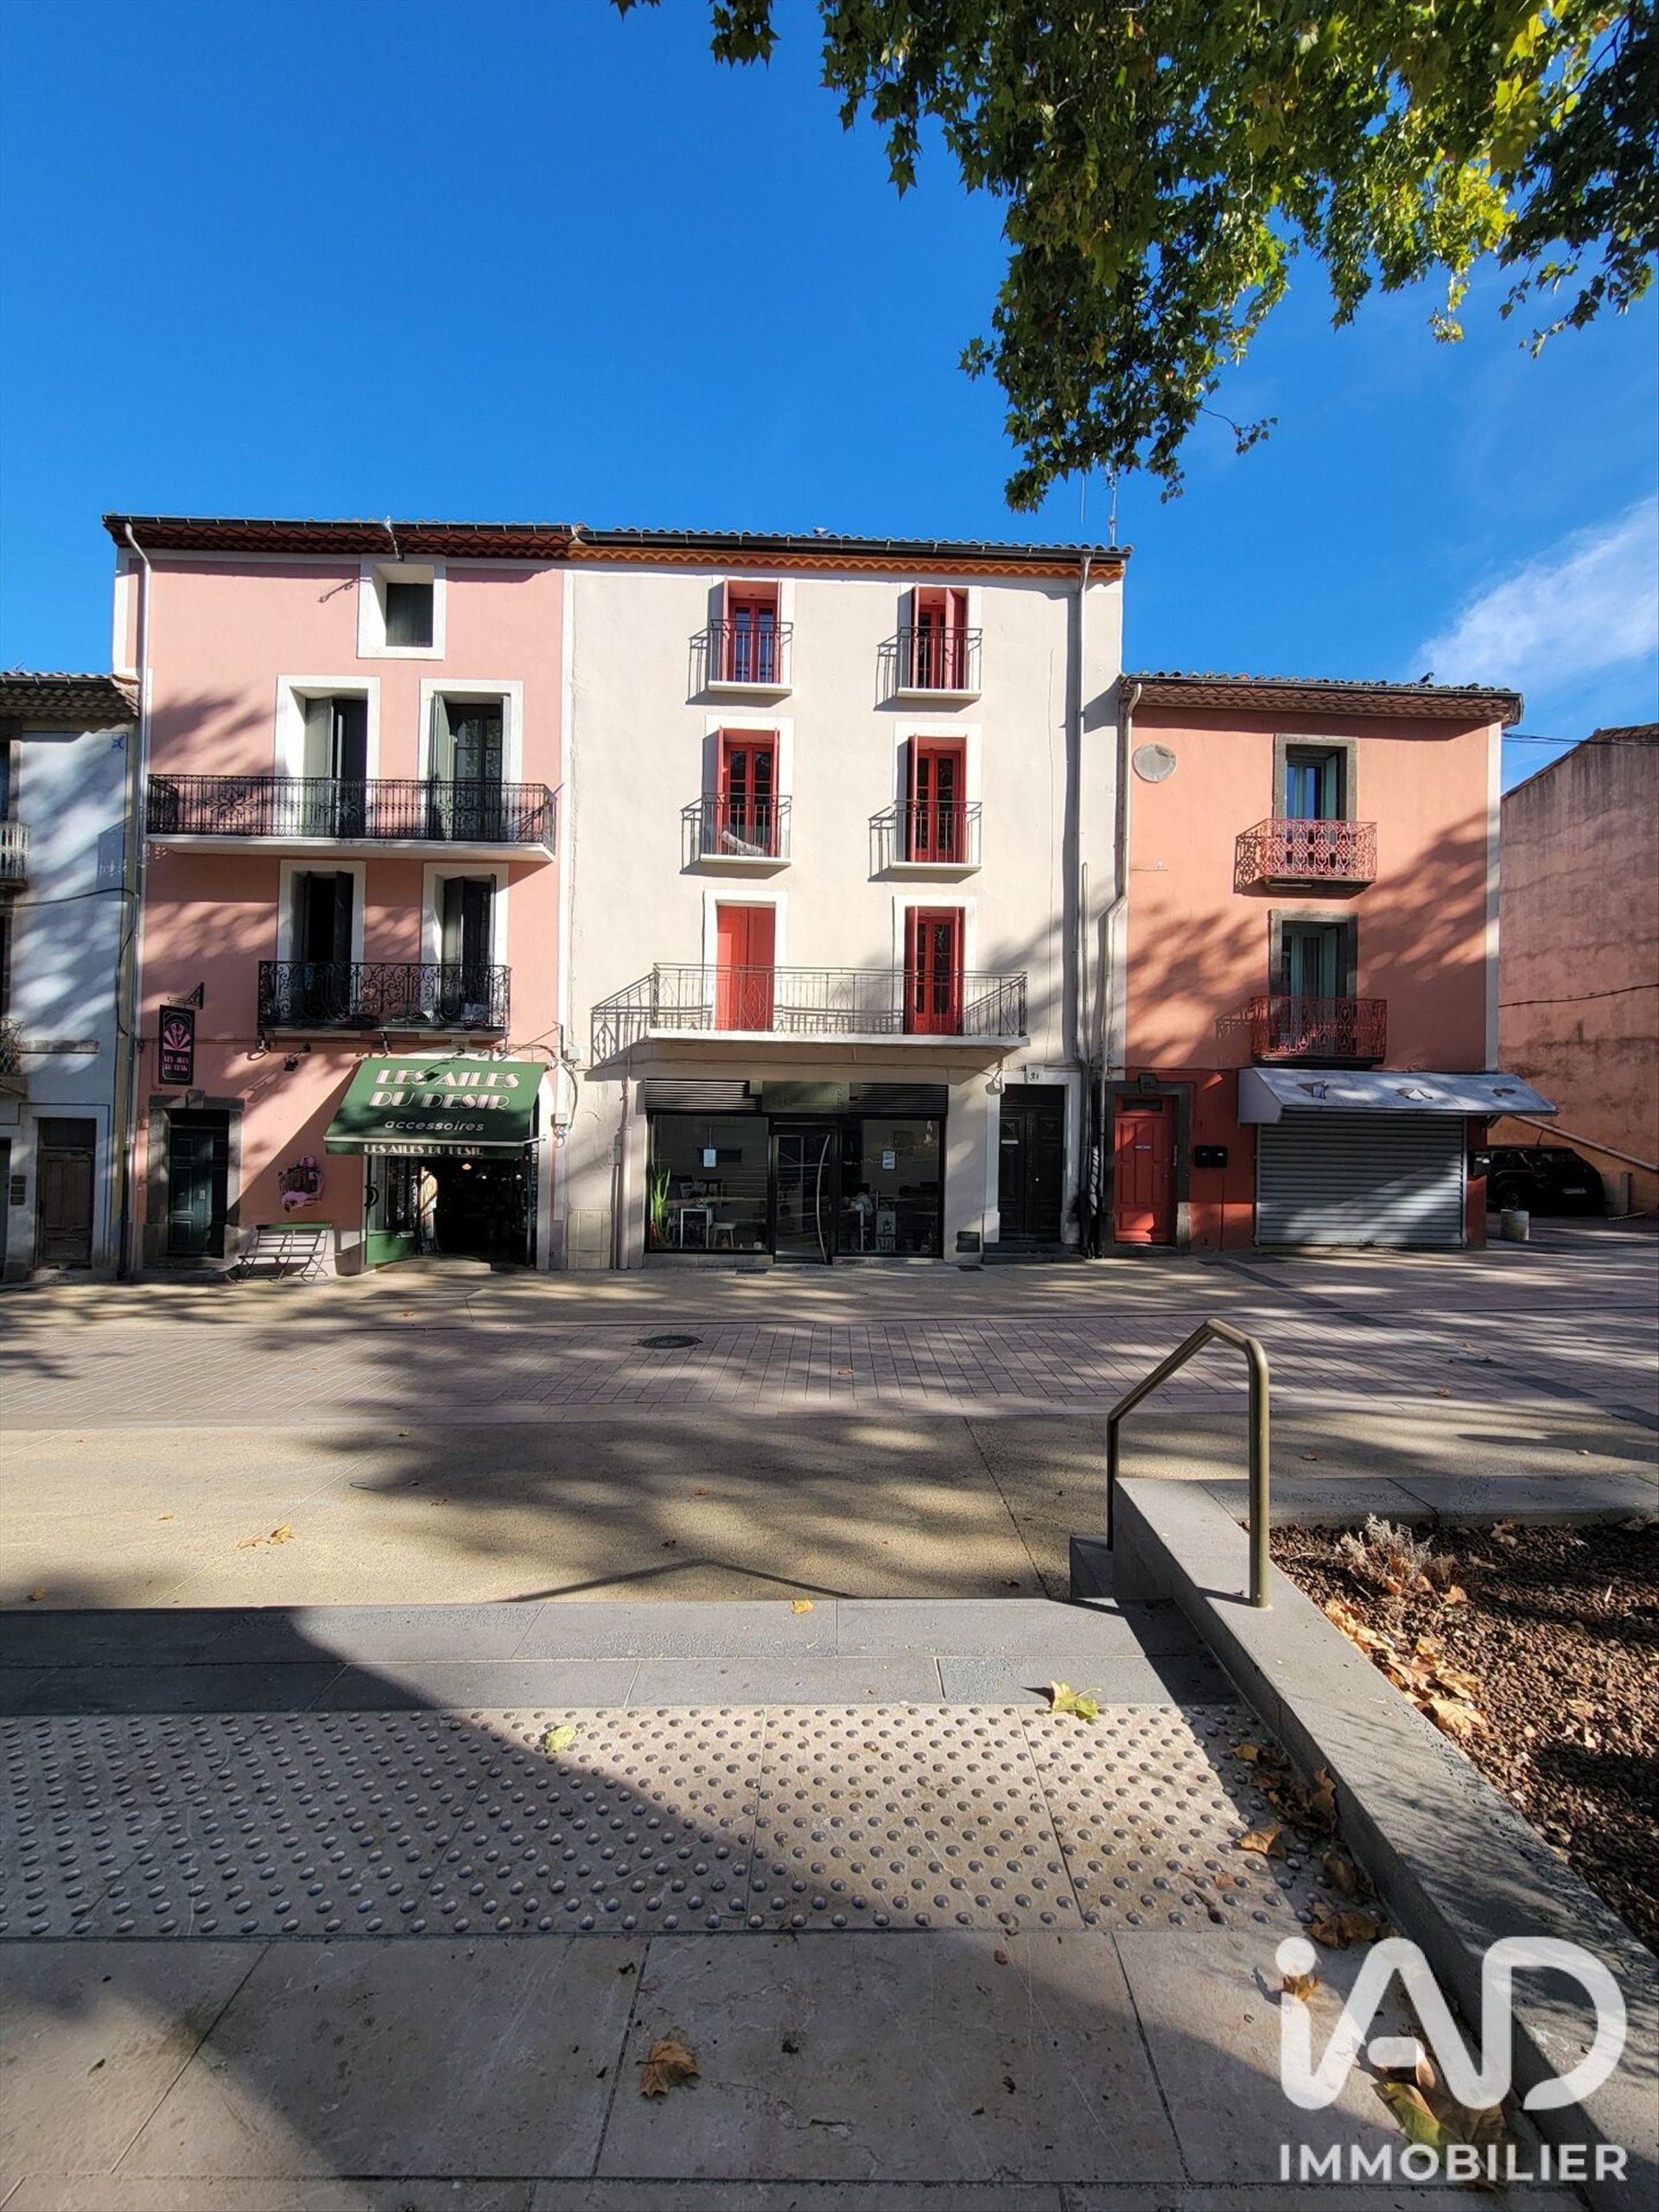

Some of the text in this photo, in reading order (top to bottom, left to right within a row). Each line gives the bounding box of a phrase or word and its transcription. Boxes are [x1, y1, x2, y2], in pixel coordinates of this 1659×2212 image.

[375, 1069, 520, 1088] LES AILES
[369, 1091, 510, 1110] DU DESIR
[385, 1121, 485, 1131] accessoires
[364, 1144, 485, 1156] LES AILES DU DESIR
